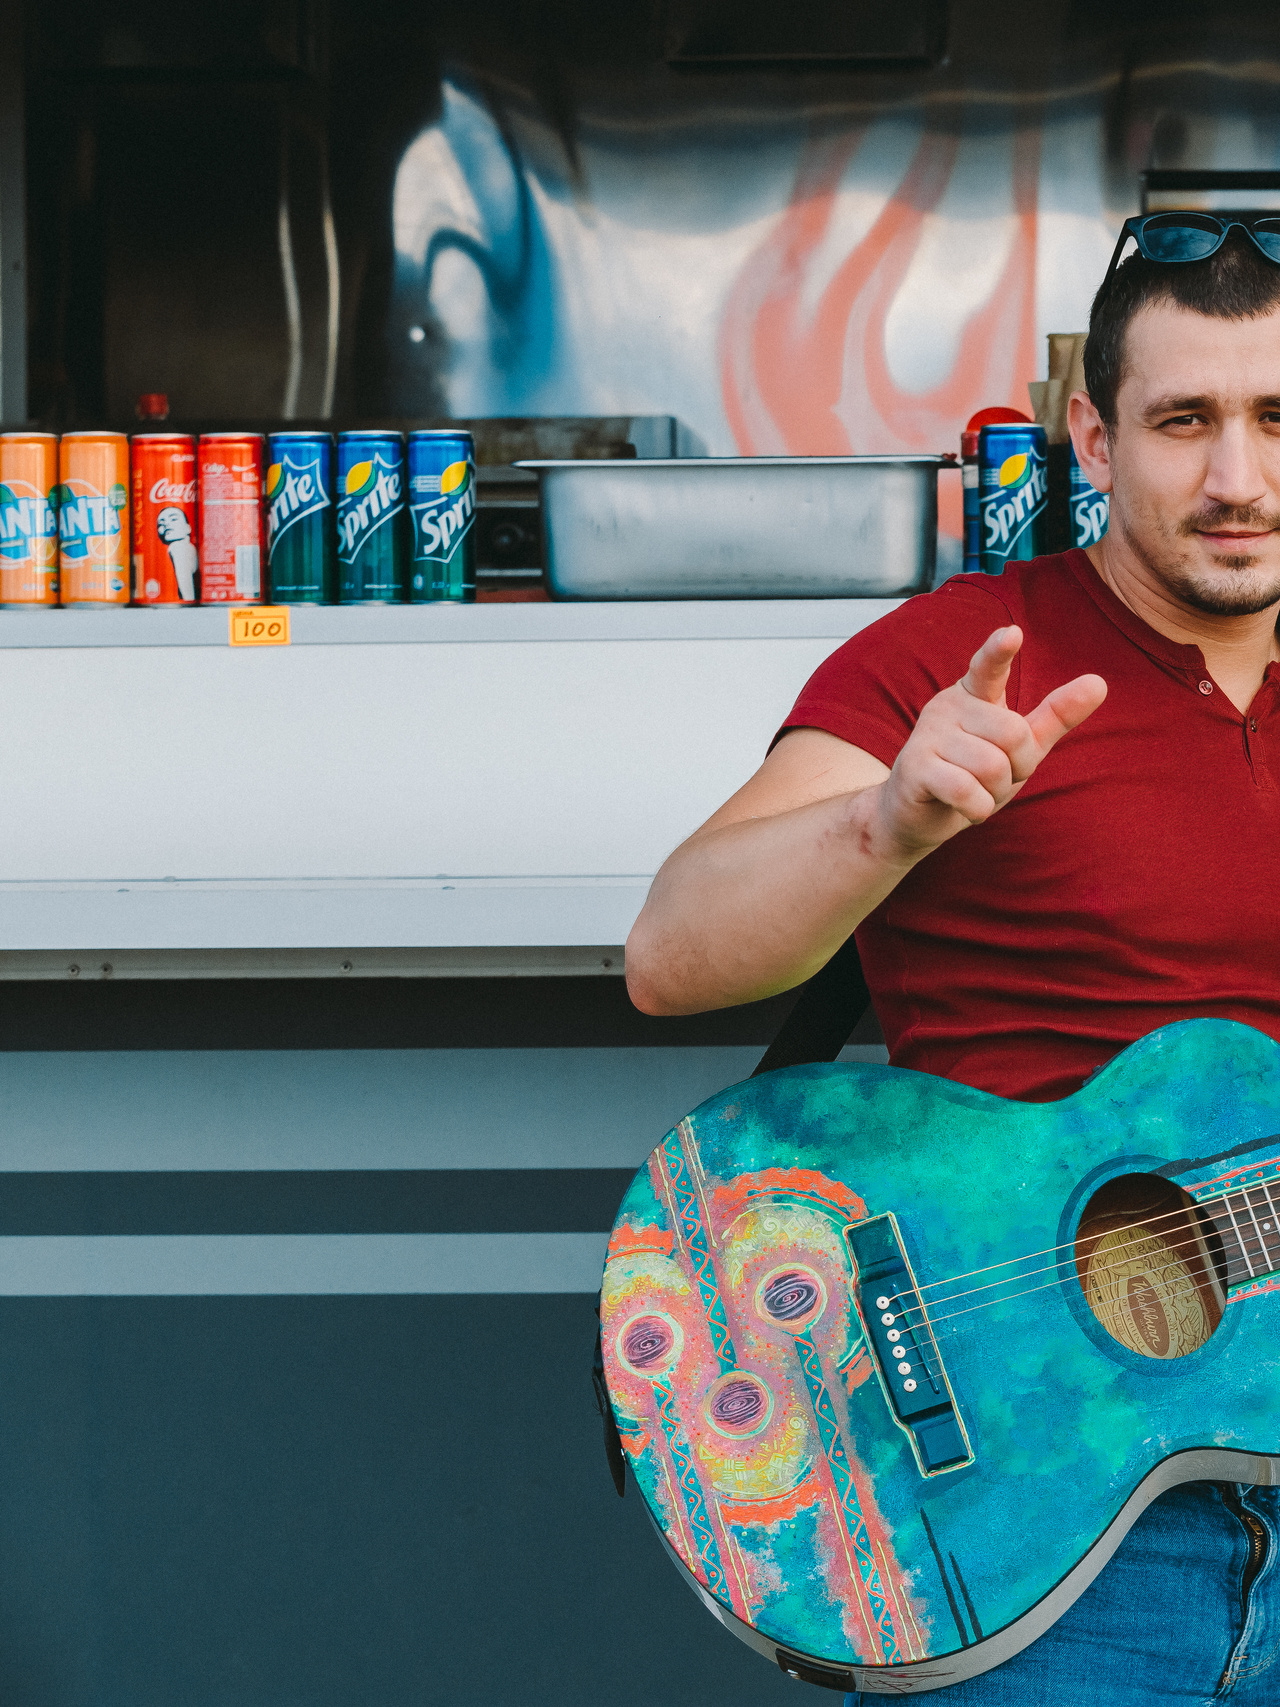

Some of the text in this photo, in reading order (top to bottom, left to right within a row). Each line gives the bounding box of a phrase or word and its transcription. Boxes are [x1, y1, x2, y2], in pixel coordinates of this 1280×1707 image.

[0, 498, 56, 538] NTA
[60, 497, 122, 537] NTA
[268, 472, 315, 548] rite
[421, 480, 475, 554] Spri
[244, 621, 282, 637] 100
[1124, 1310, 1146, 1349] XCELLENCE
[1131, 1280, 1160, 1348] Washburn
